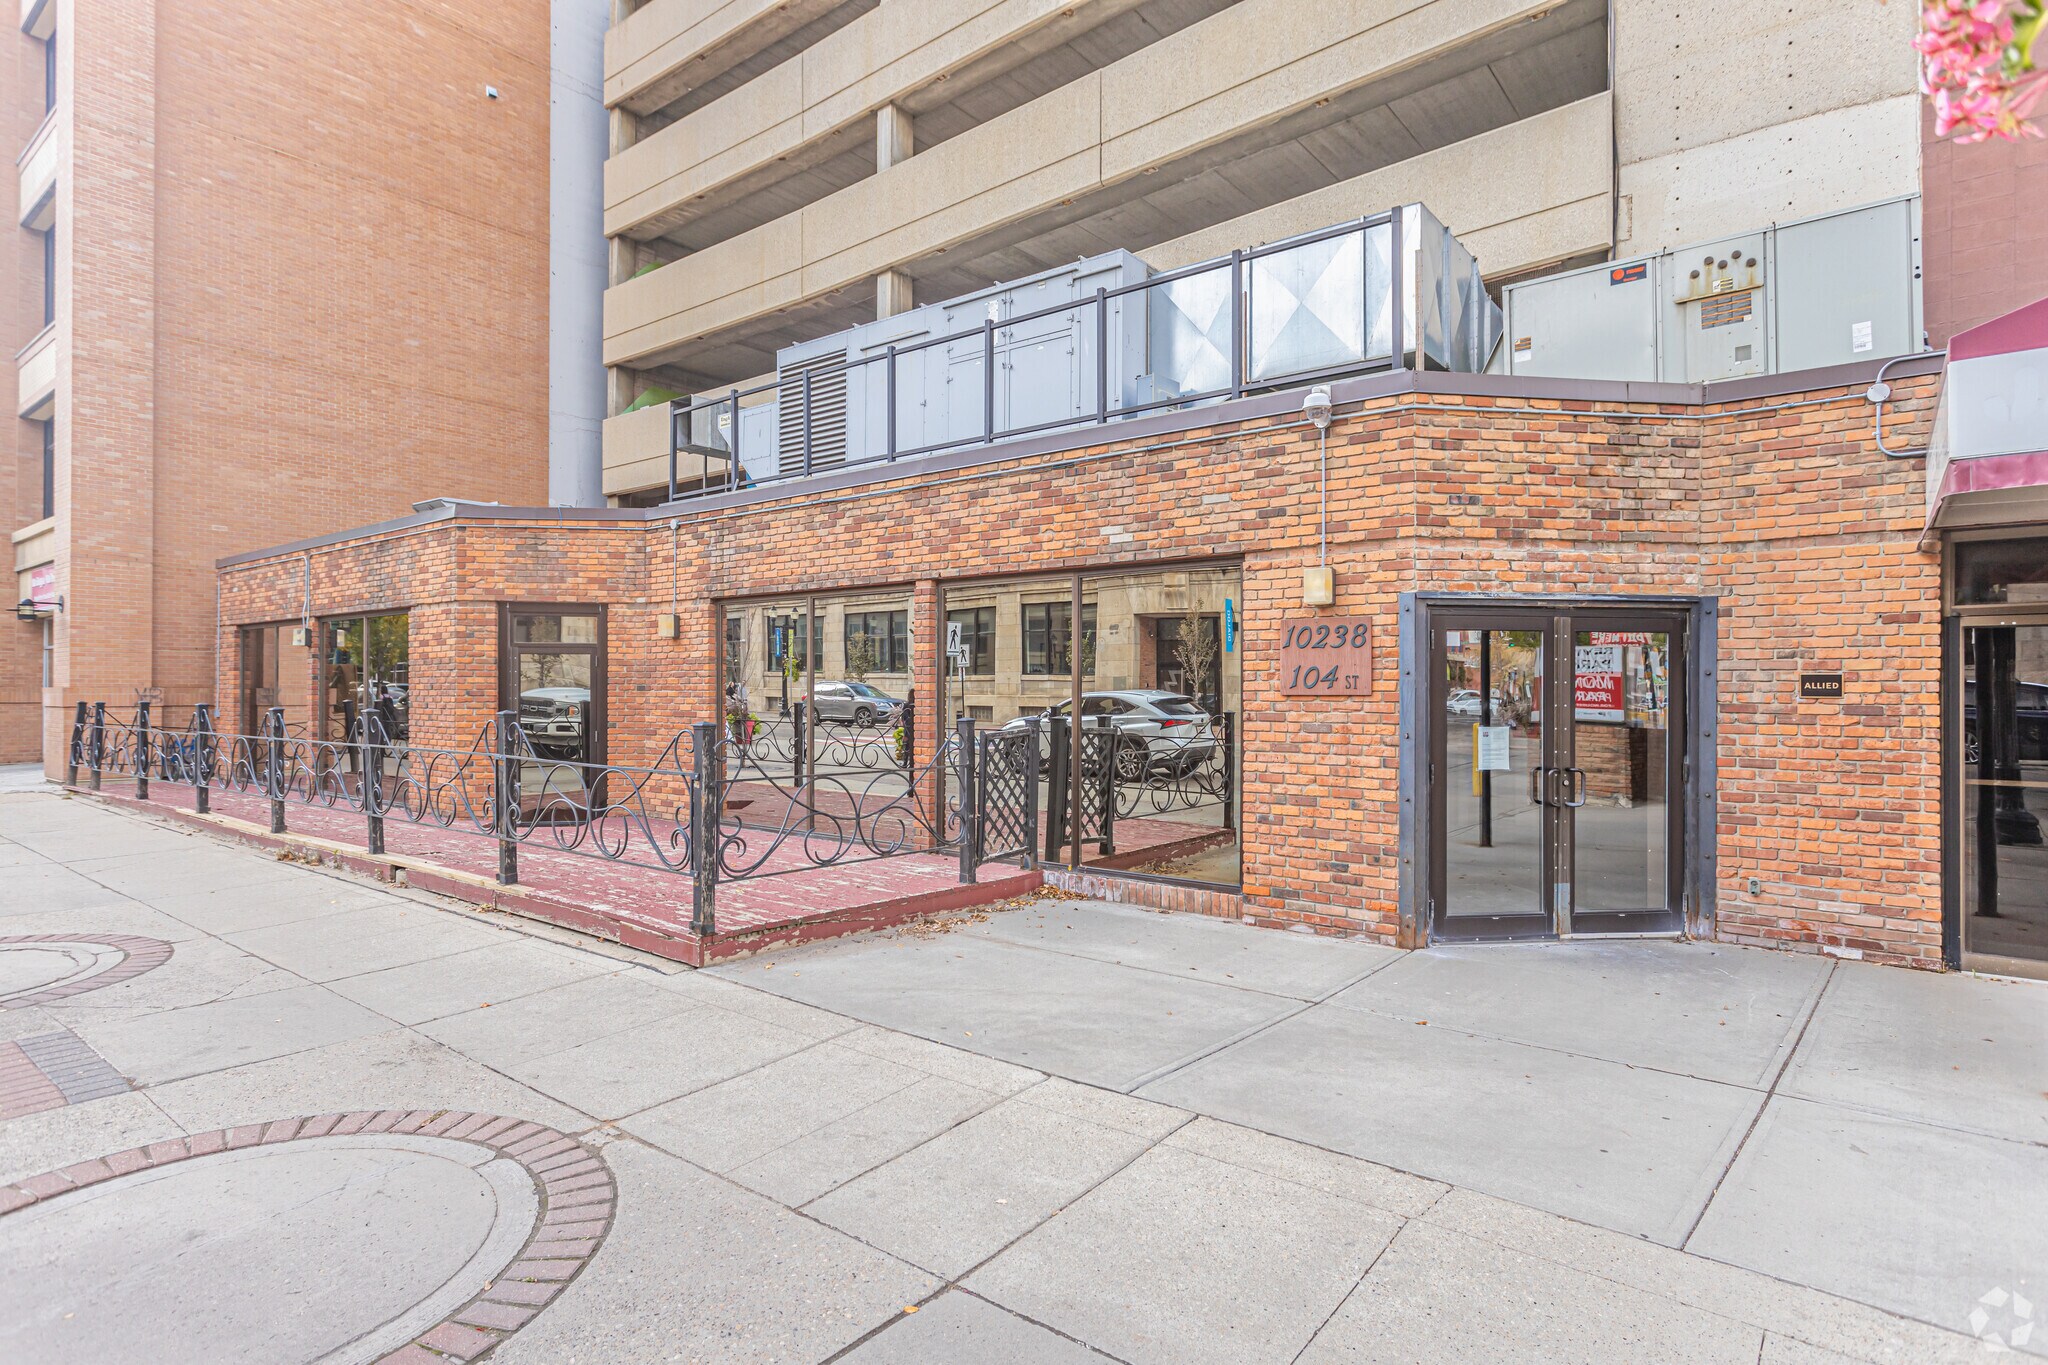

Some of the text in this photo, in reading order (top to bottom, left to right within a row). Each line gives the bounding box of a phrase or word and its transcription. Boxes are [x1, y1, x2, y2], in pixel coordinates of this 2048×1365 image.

[1282, 623, 1368, 649] 10238
[1289, 664, 1359, 690] 104 ST
